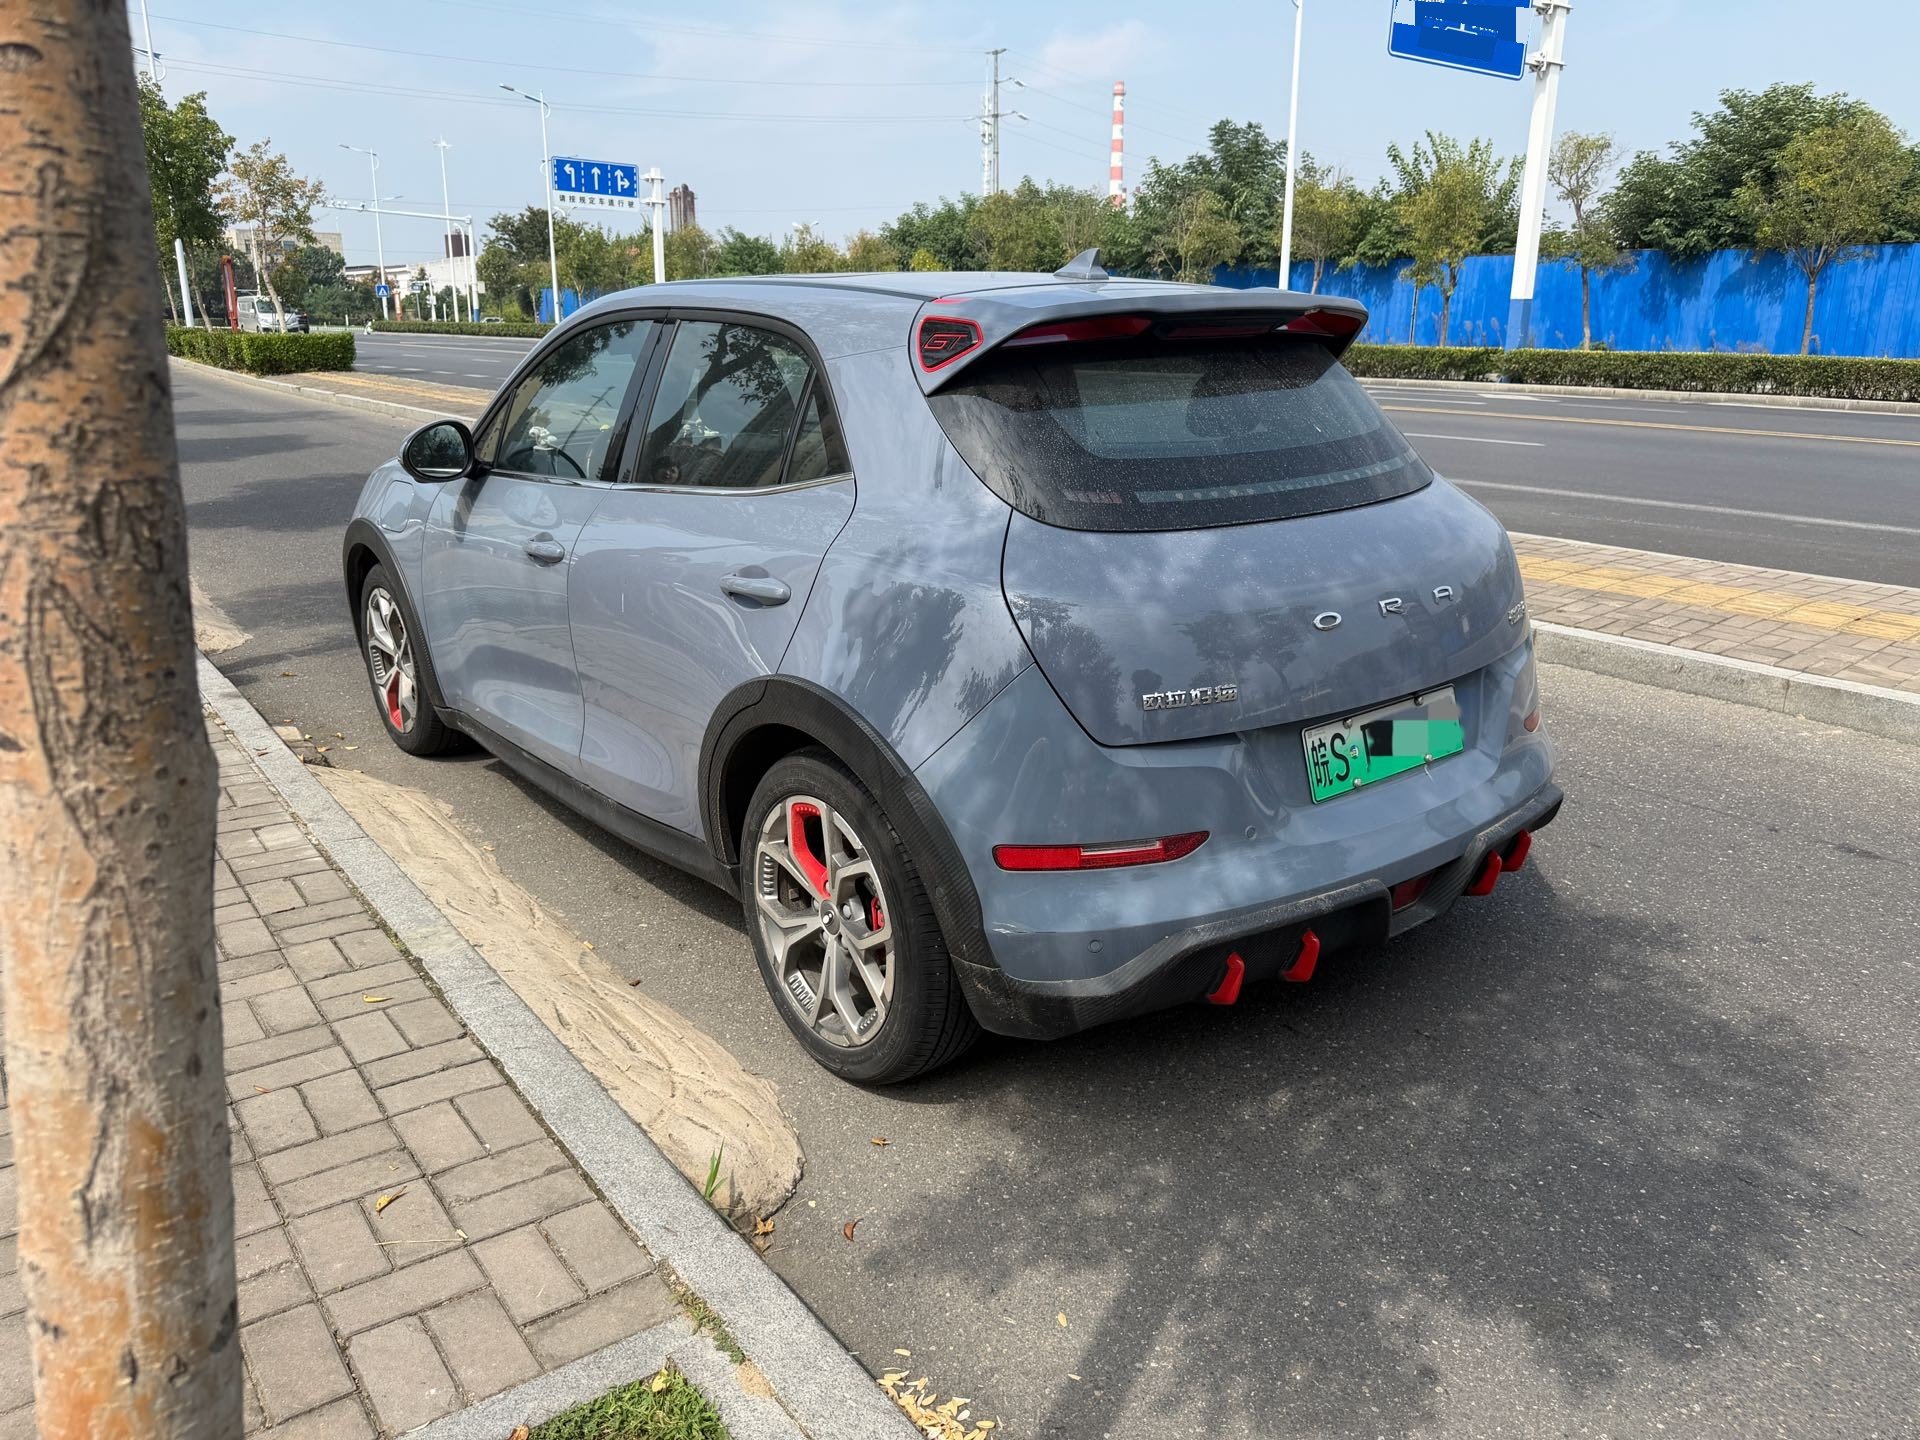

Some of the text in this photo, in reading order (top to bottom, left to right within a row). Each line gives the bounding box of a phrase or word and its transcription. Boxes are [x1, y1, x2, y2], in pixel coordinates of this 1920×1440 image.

[922, 332, 968, 351] GT
[1313, 585, 1453, 631] ORA
[1142, 683, 1237, 711] 欧拉好猫
